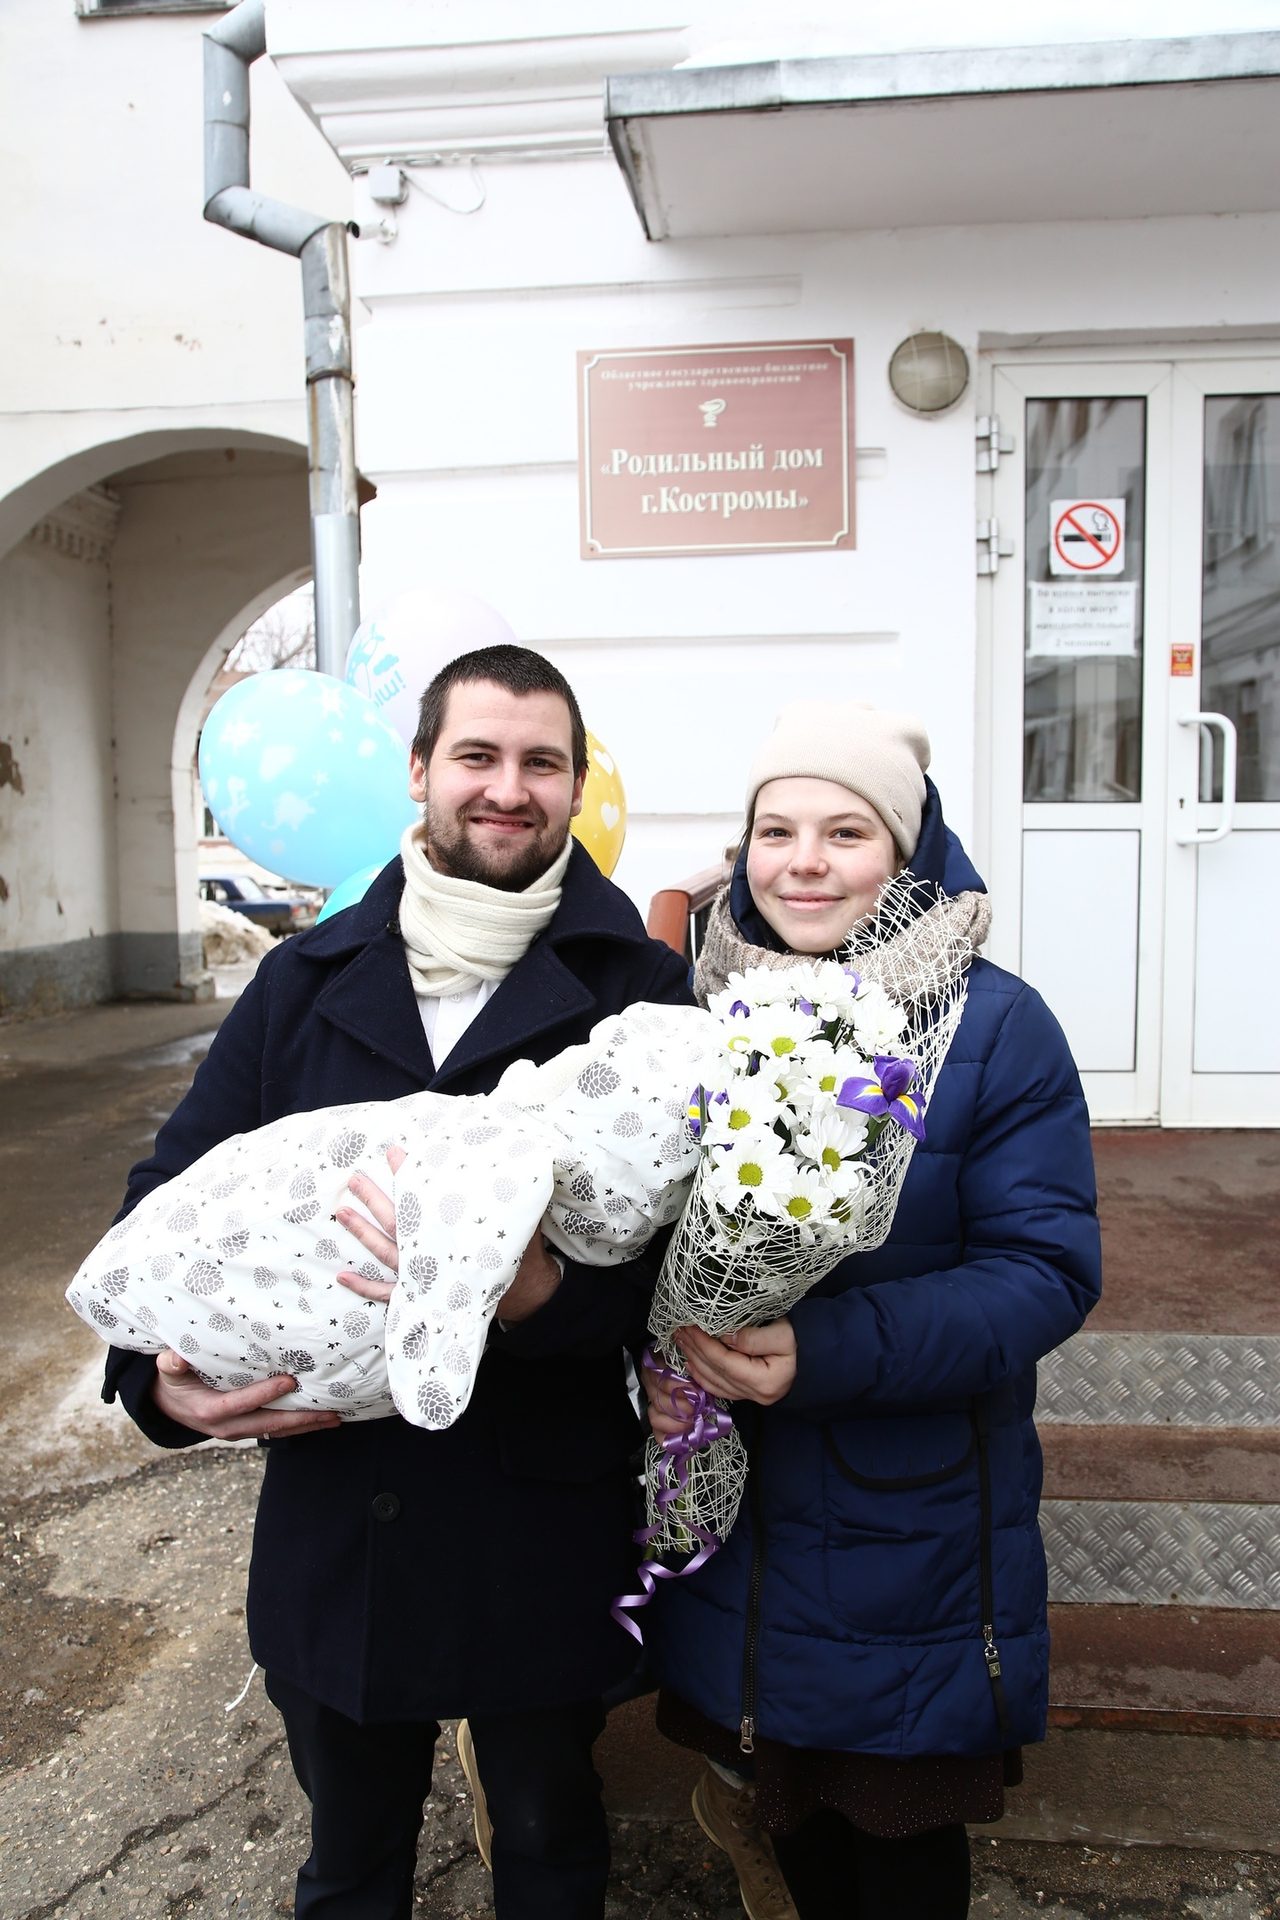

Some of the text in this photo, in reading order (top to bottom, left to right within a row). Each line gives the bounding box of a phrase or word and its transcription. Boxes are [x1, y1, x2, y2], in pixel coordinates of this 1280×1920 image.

[600, 444, 824, 477] «Родильный дом
[641, 486, 809, 518] г.Костромы»
